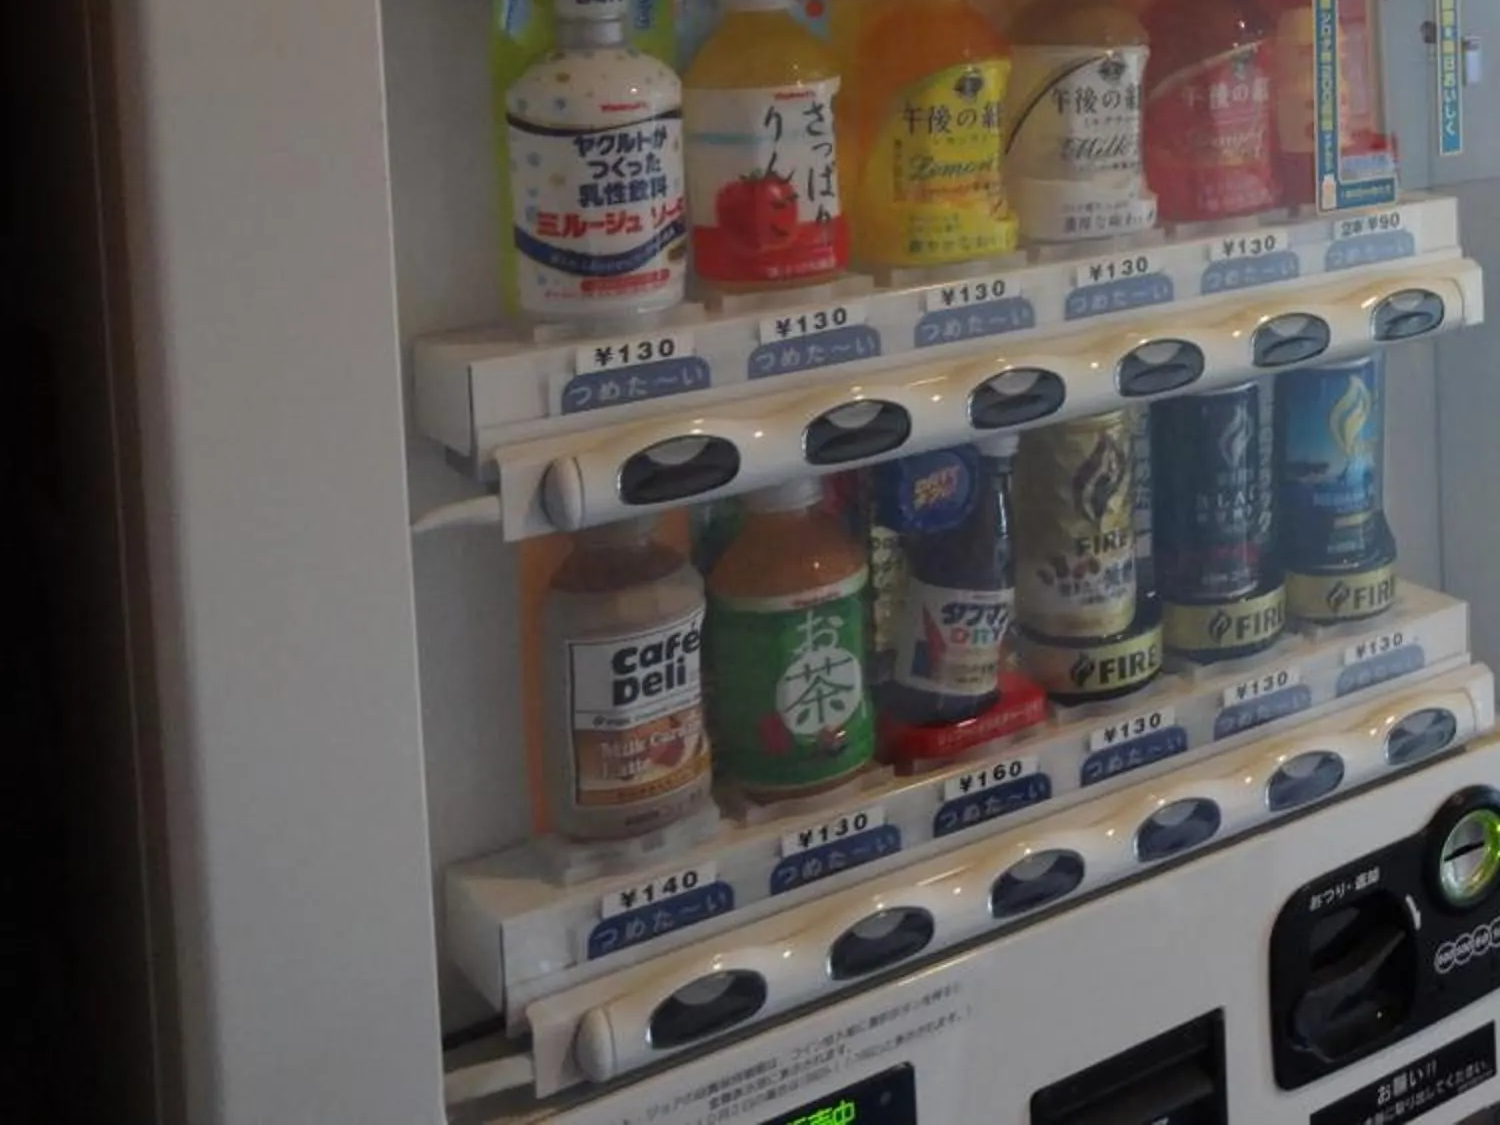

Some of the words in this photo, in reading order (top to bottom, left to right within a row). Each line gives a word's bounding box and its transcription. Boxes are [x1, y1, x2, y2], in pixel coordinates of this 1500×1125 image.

[572, 128, 668, 158] ヤクルトが
[1223, 235, 1277, 258] ¥130
[1089, 256, 1149, 282] ¥130
[941, 279, 1006, 306] ¥130
[776, 307, 847, 338] ¥130
[595, 338, 676, 365] ¥130
[611, 623, 702, 676] Café
[1355, 631, 1404, 660] ¥130
[783, 610, 857, 726] お茶
[1100, 645, 1160, 685] FIRE
[612, 655, 686, 707] Deli
[1236, 671, 1288, 700] ¥130
[1103, 712, 1162, 743] ¥130
[959, 760, 1022, 793] ¥160
[799, 812, 868, 850] ¥130
[619, 871, 699, 909] ¥140
